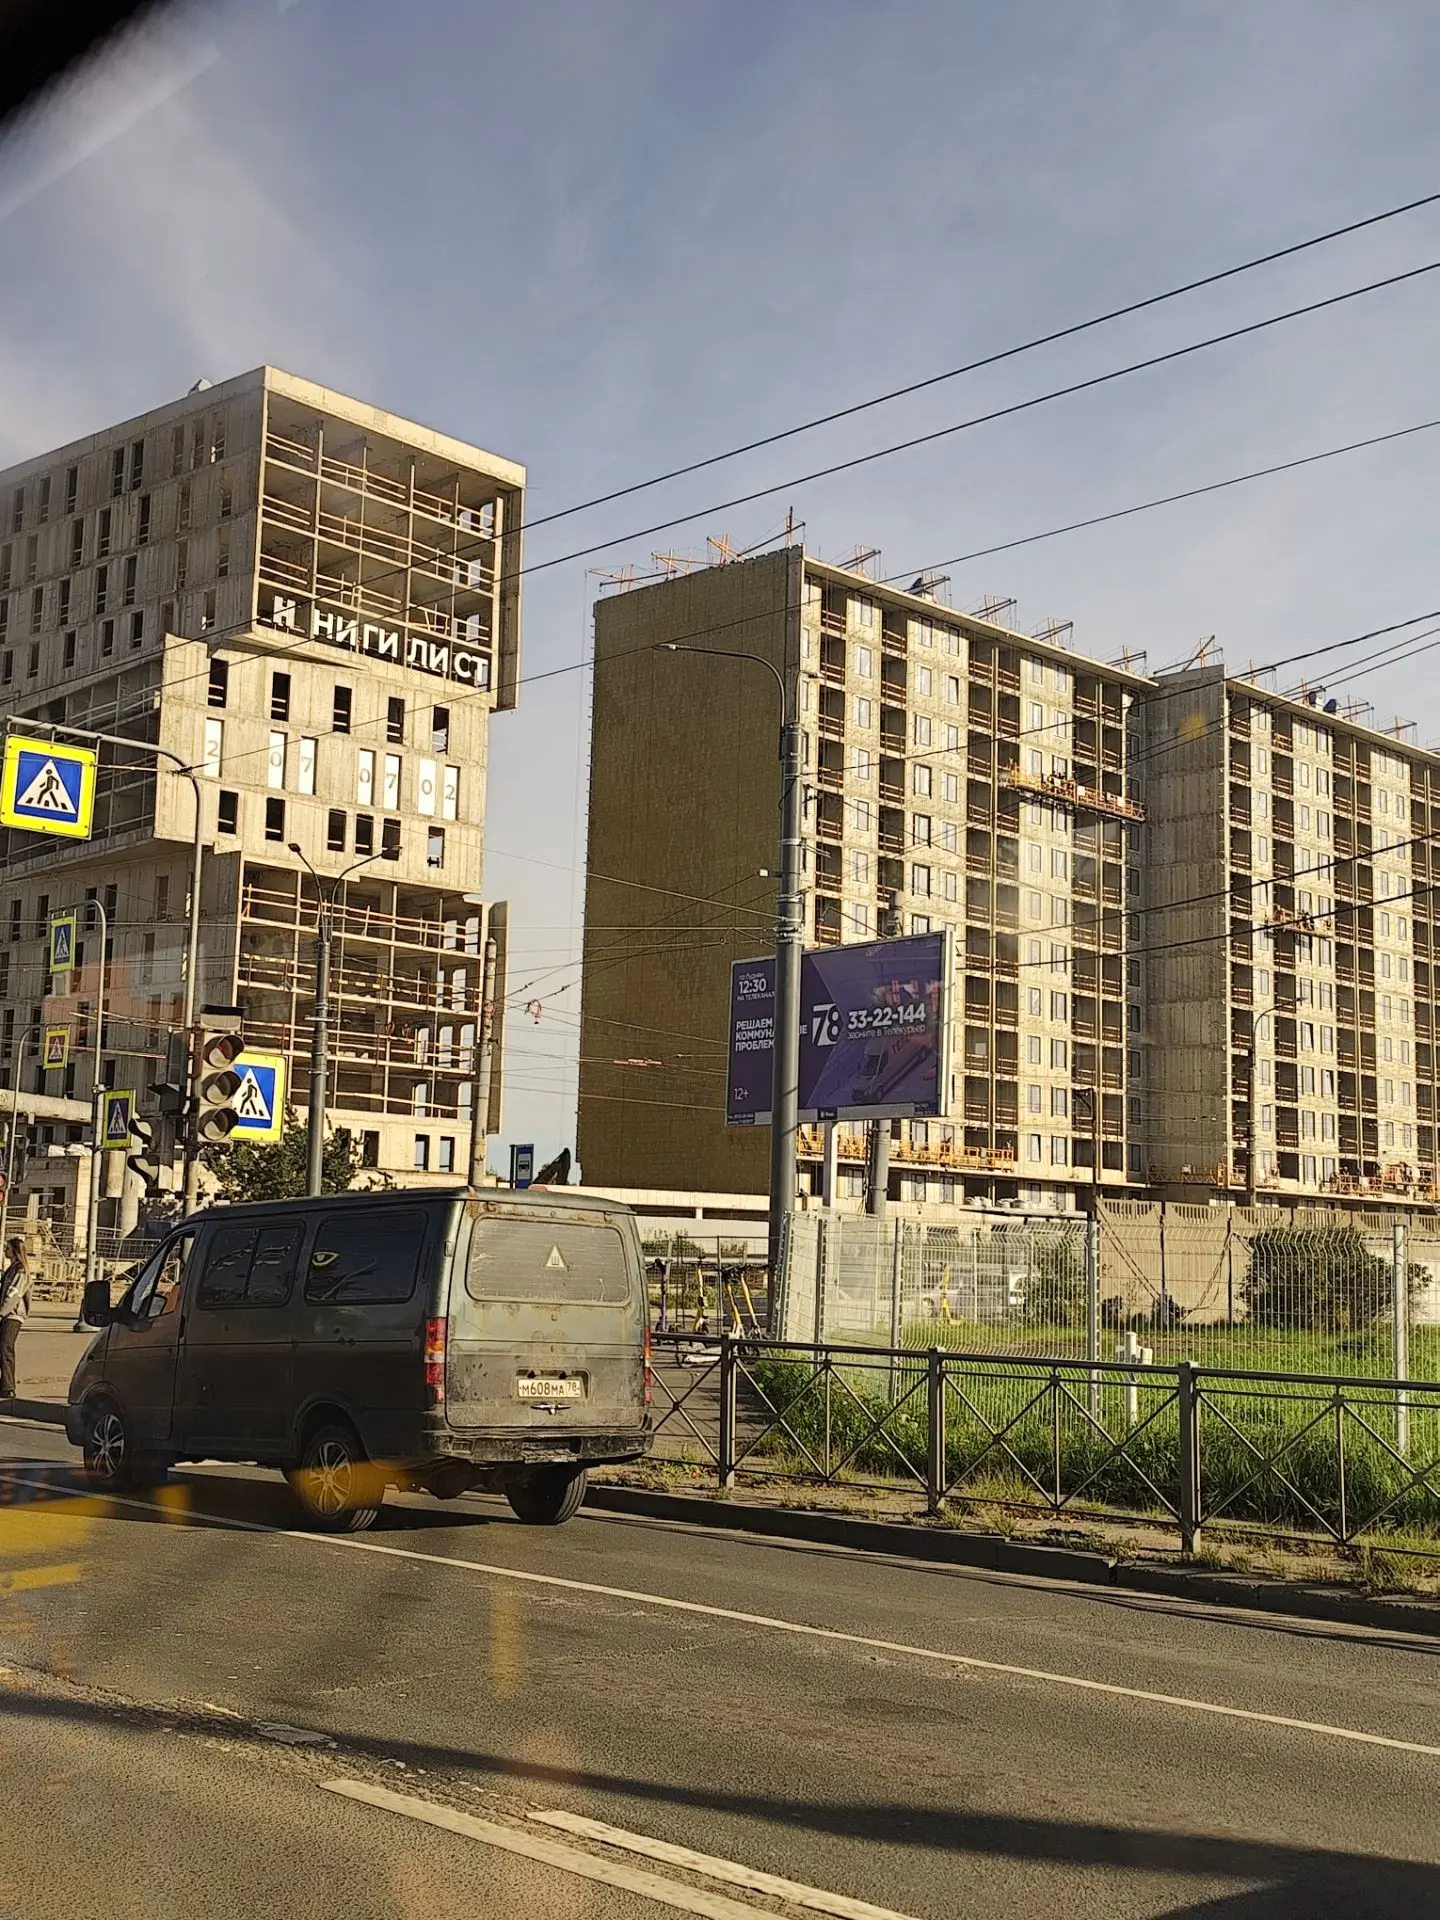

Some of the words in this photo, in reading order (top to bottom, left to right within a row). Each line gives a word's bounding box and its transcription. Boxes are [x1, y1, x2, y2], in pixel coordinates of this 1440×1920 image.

[739, 978, 767, 995] 12:30
[847, 1003, 927, 1030] 33-22-144
[736, 1018, 773, 1031] РЕШАЕМ
[812, 1003, 841, 1046] 78
[735, 1039, 775, 1052] ПРОБЛЕМ
[734, 1087, 749, 1100] 12+
[522, 1382, 565, 1396] М608МА
[567, 1381, 578, 1392] 78
